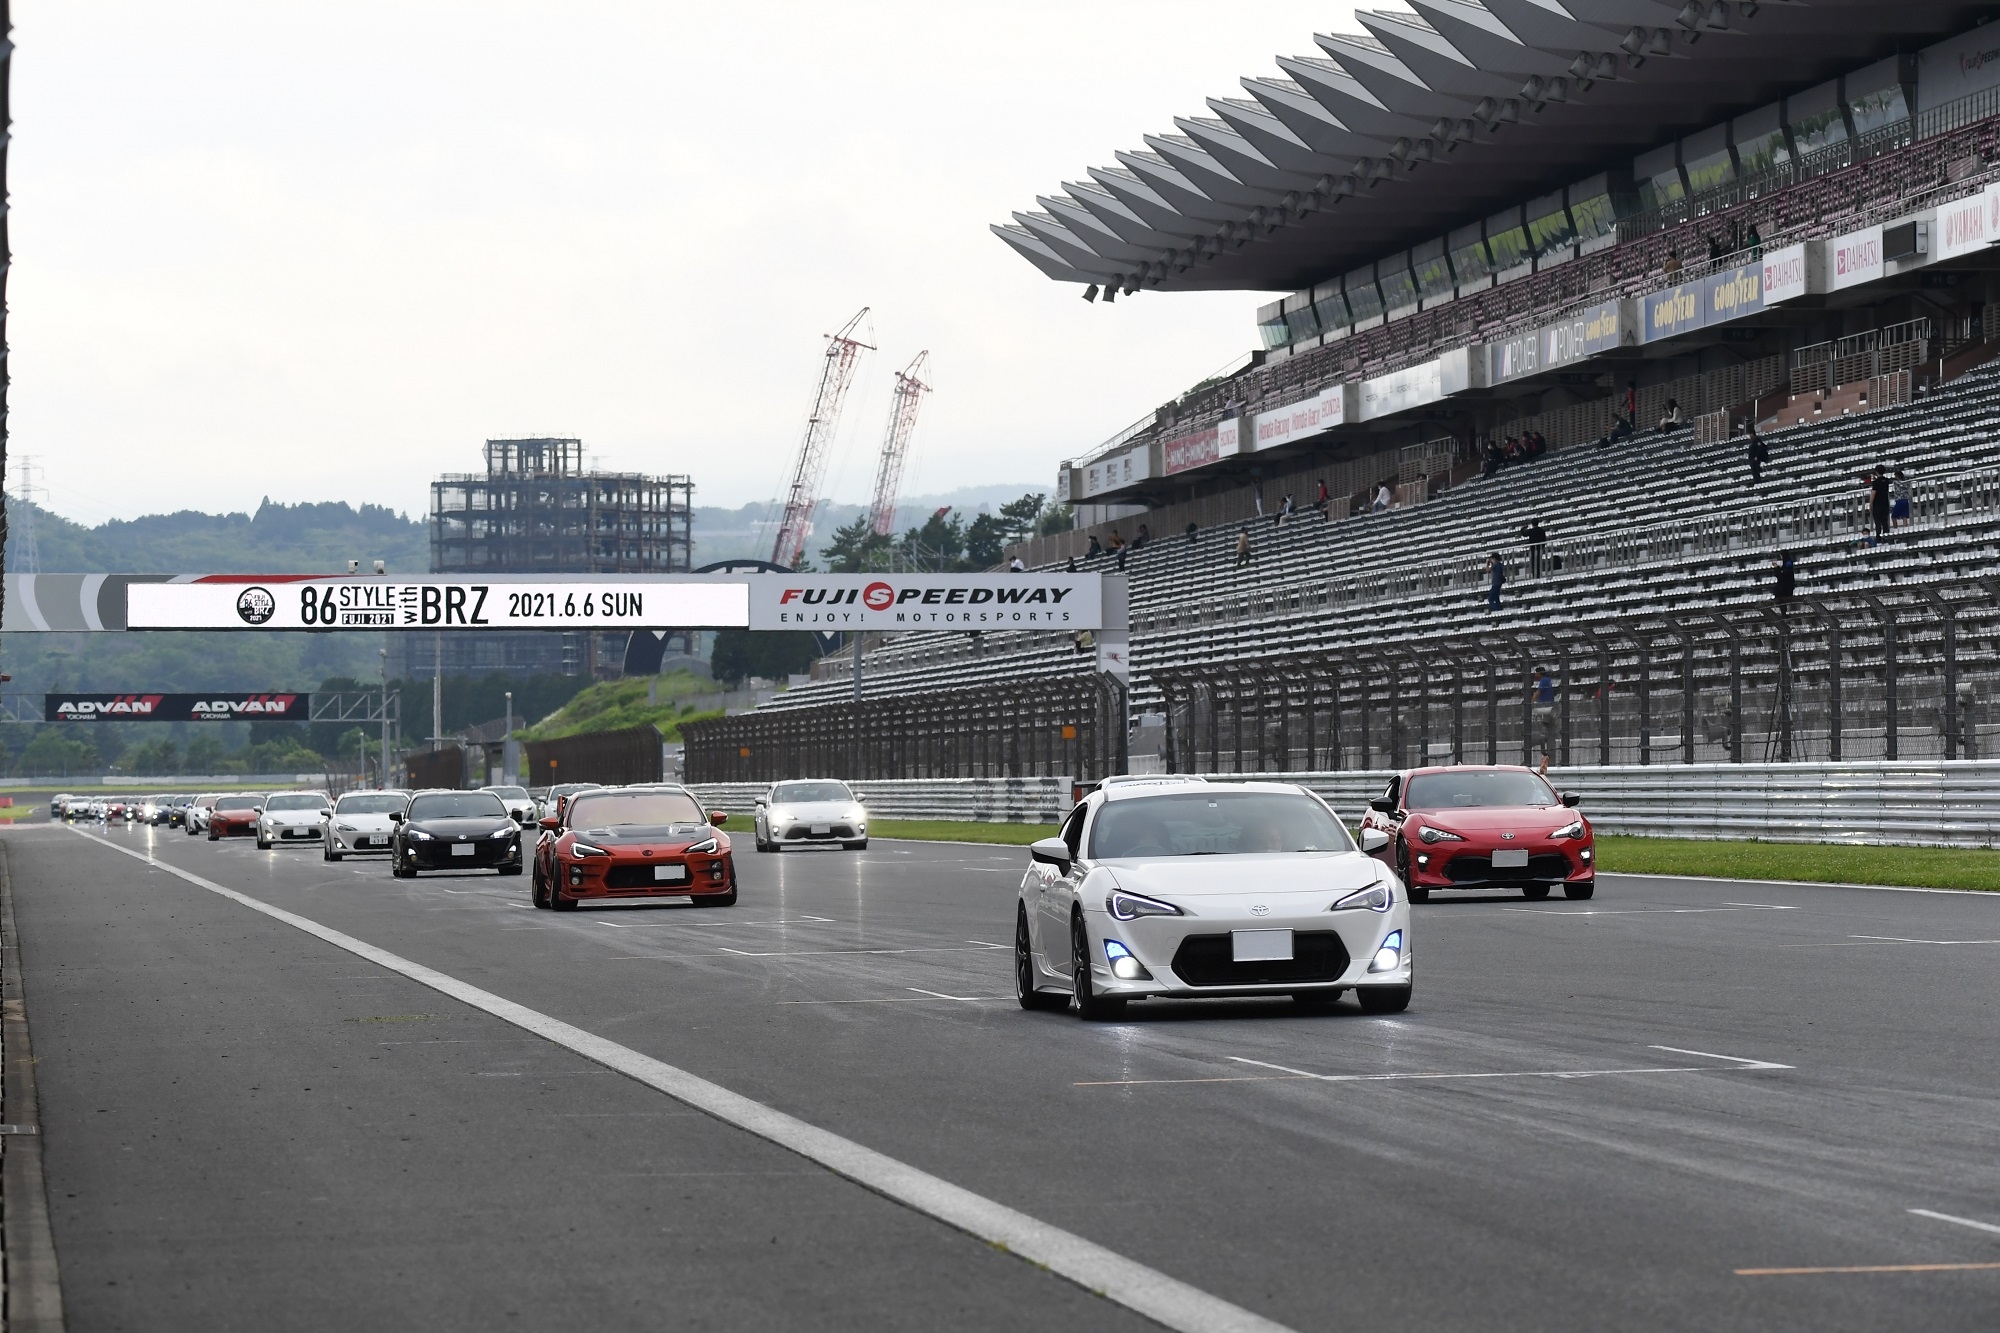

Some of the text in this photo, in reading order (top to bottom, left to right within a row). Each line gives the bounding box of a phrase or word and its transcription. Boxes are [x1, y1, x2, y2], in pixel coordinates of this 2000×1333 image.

[1954, 205, 1983, 246] YAMAHA
[1845, 240, 1880, 273] DAIHATSU
[1772, 258, 1803, 290] DAIHATSU
[1713, 275, 1759, 312] GOODYEAR
[1654, 293, 1696, 328] GOODYEAR
[1559, 321, 1585, 361] POWER
[1586, 315, 1617, 342] GOODYEAR
[1512, 336, 1537, 375] POWER
[1321, 397, 1341, 419] HONDA
[1220, 429, 1237, 448] HONDA
[1259, 421, 1274, 441] Honda
[1274, 418, 1290, 439] Racing
[1292, 411, 1308, 432] Honda
[301, 586, 643, 625] 86 STYLE with BRZ 2021.6.6 SUN
[780, 583, 1073, 609] FUJI SPEEDWAY
[253, 606, 270, 615] BRZ
[343, 614, 393, 624] FUJI 2021
[780, 611, 1070, 623] ENJOY! MOTORSPORTS
[57, 701, 152, 713] ADVAN
[66, 712, 97, 720] YOKOHAMA
[191, 700, 285, 713] ADVAN
[200, 712, 231, 720] YOKOHAMA
